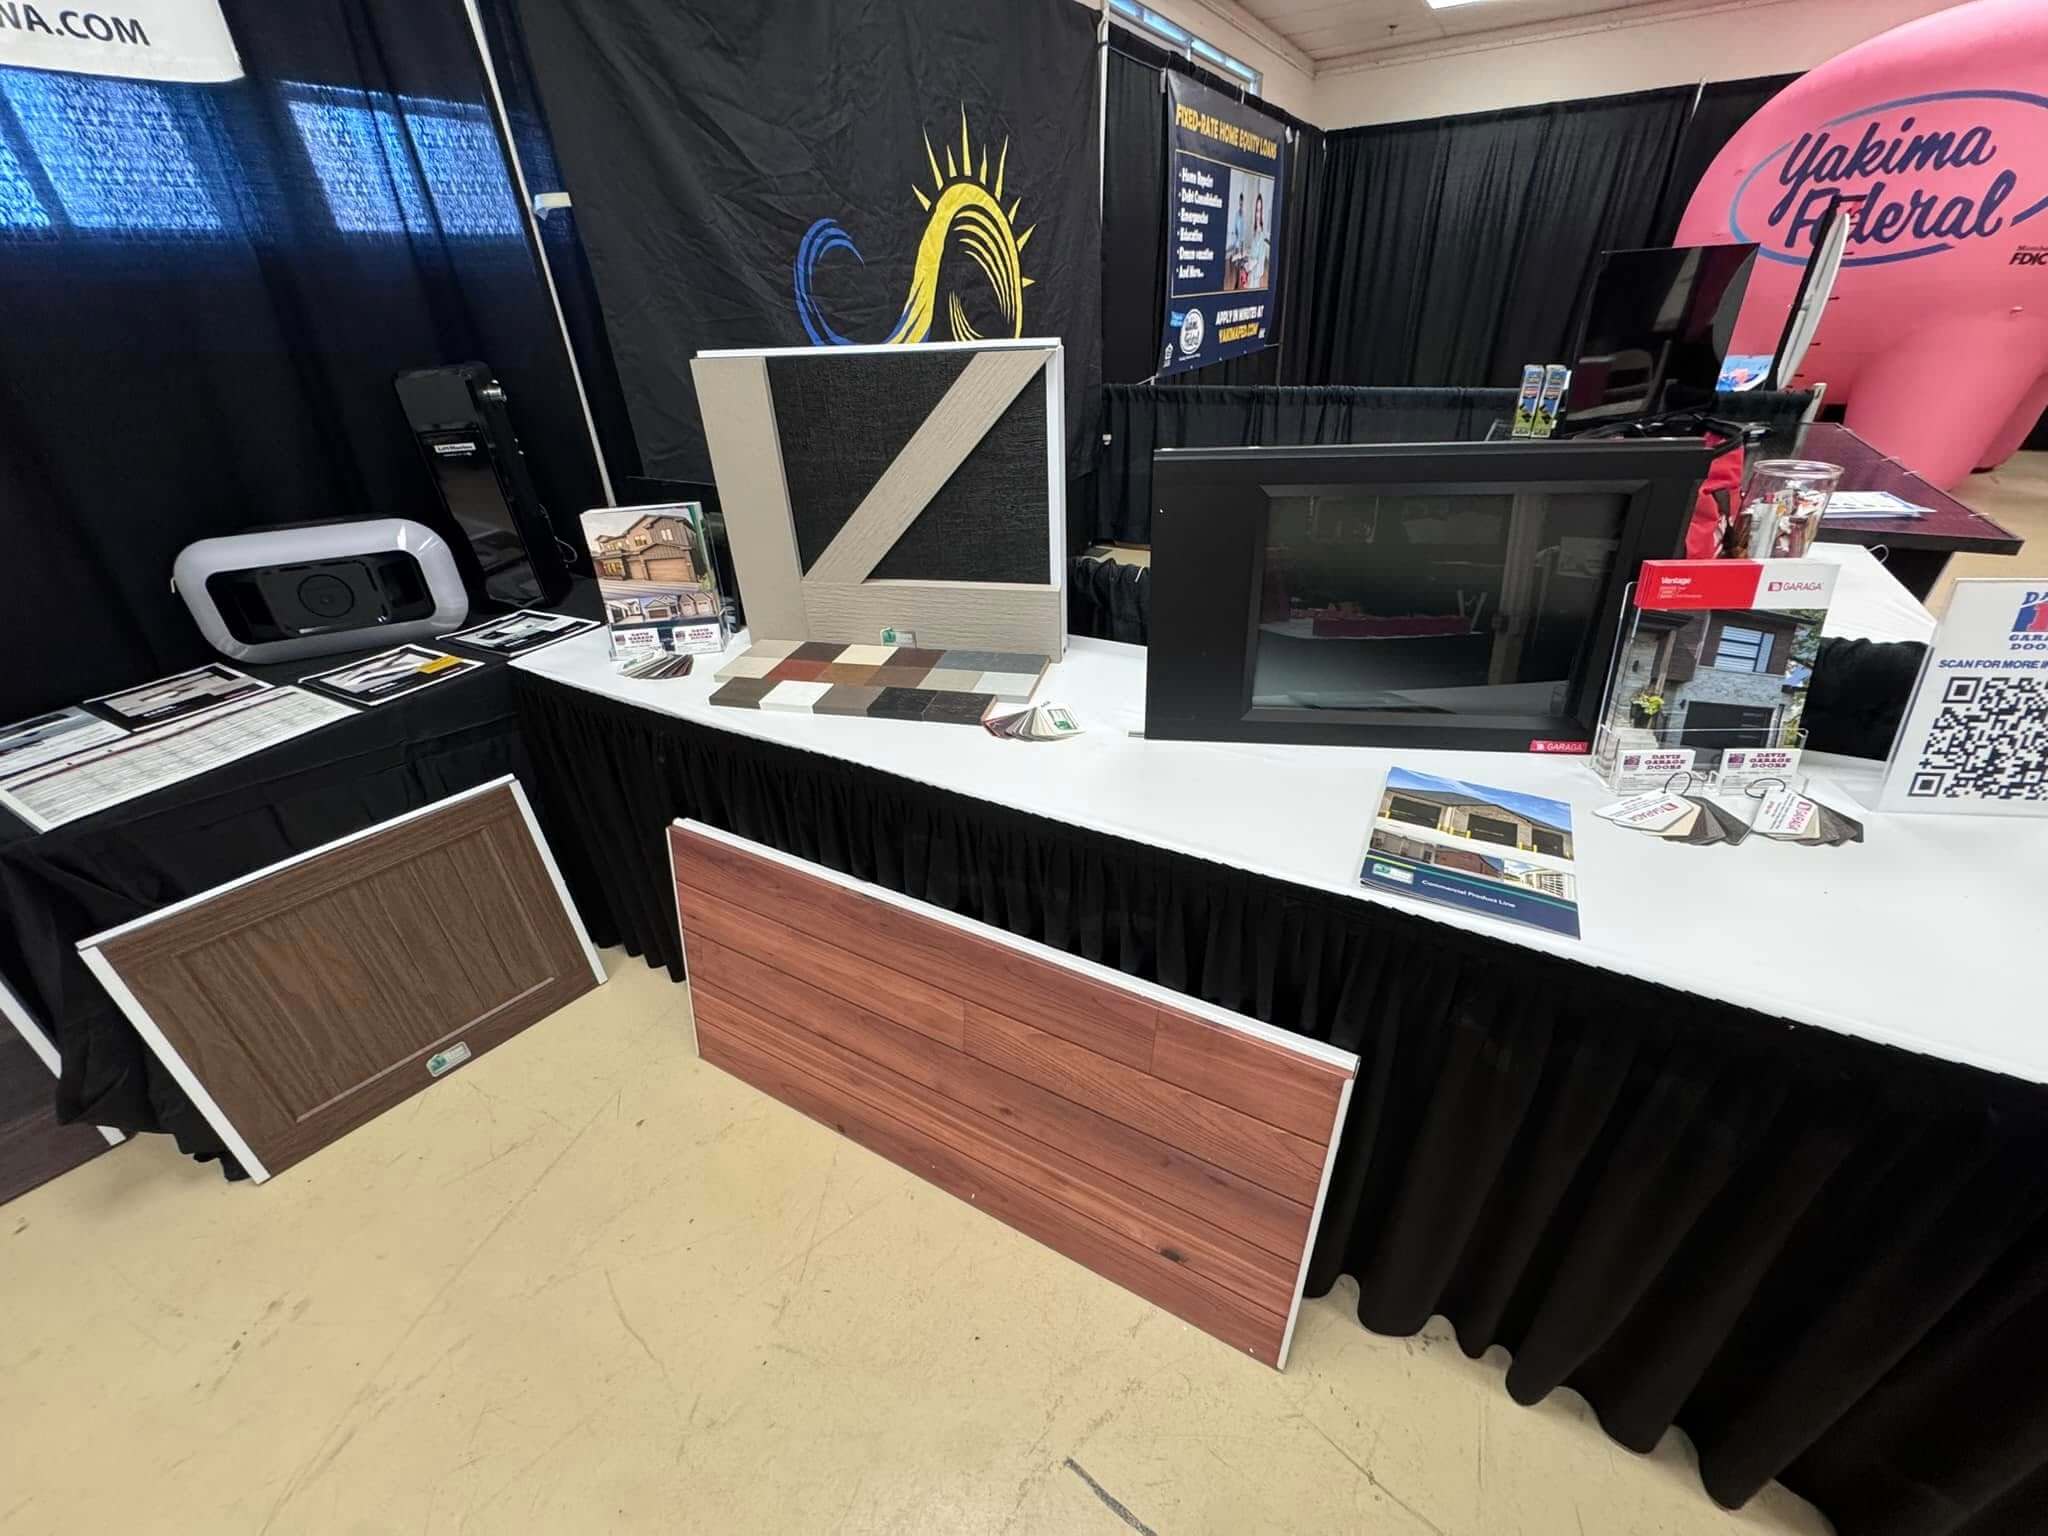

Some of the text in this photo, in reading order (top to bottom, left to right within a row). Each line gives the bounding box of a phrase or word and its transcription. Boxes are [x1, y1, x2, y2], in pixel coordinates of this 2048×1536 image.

[1176, 104, 1219, 139] FIXED-RATE
[1219, 120, 1239, 146] HOME
[1239, 129, 1259, 153] EQUITY
[1768, 117, 1997, 226] Yakima
[2009, 252, 2048, 266] FDIC
[1215, 309, 1232, 326] APPLY
[1232, 308, 1239, 322] IN
[1257, 305, 1264, 318] AT
[1661, 576, 1692, 586] Vantage
[1783, 582, 1821, 591] GARAGA
[1939, 660, 1974, 669] SCAN
[1974, 660, 2001, 669] FOR
[2001, 660, 2040, 669] MORE
[1421, 879, 1516, 908] Commercial Product Line
